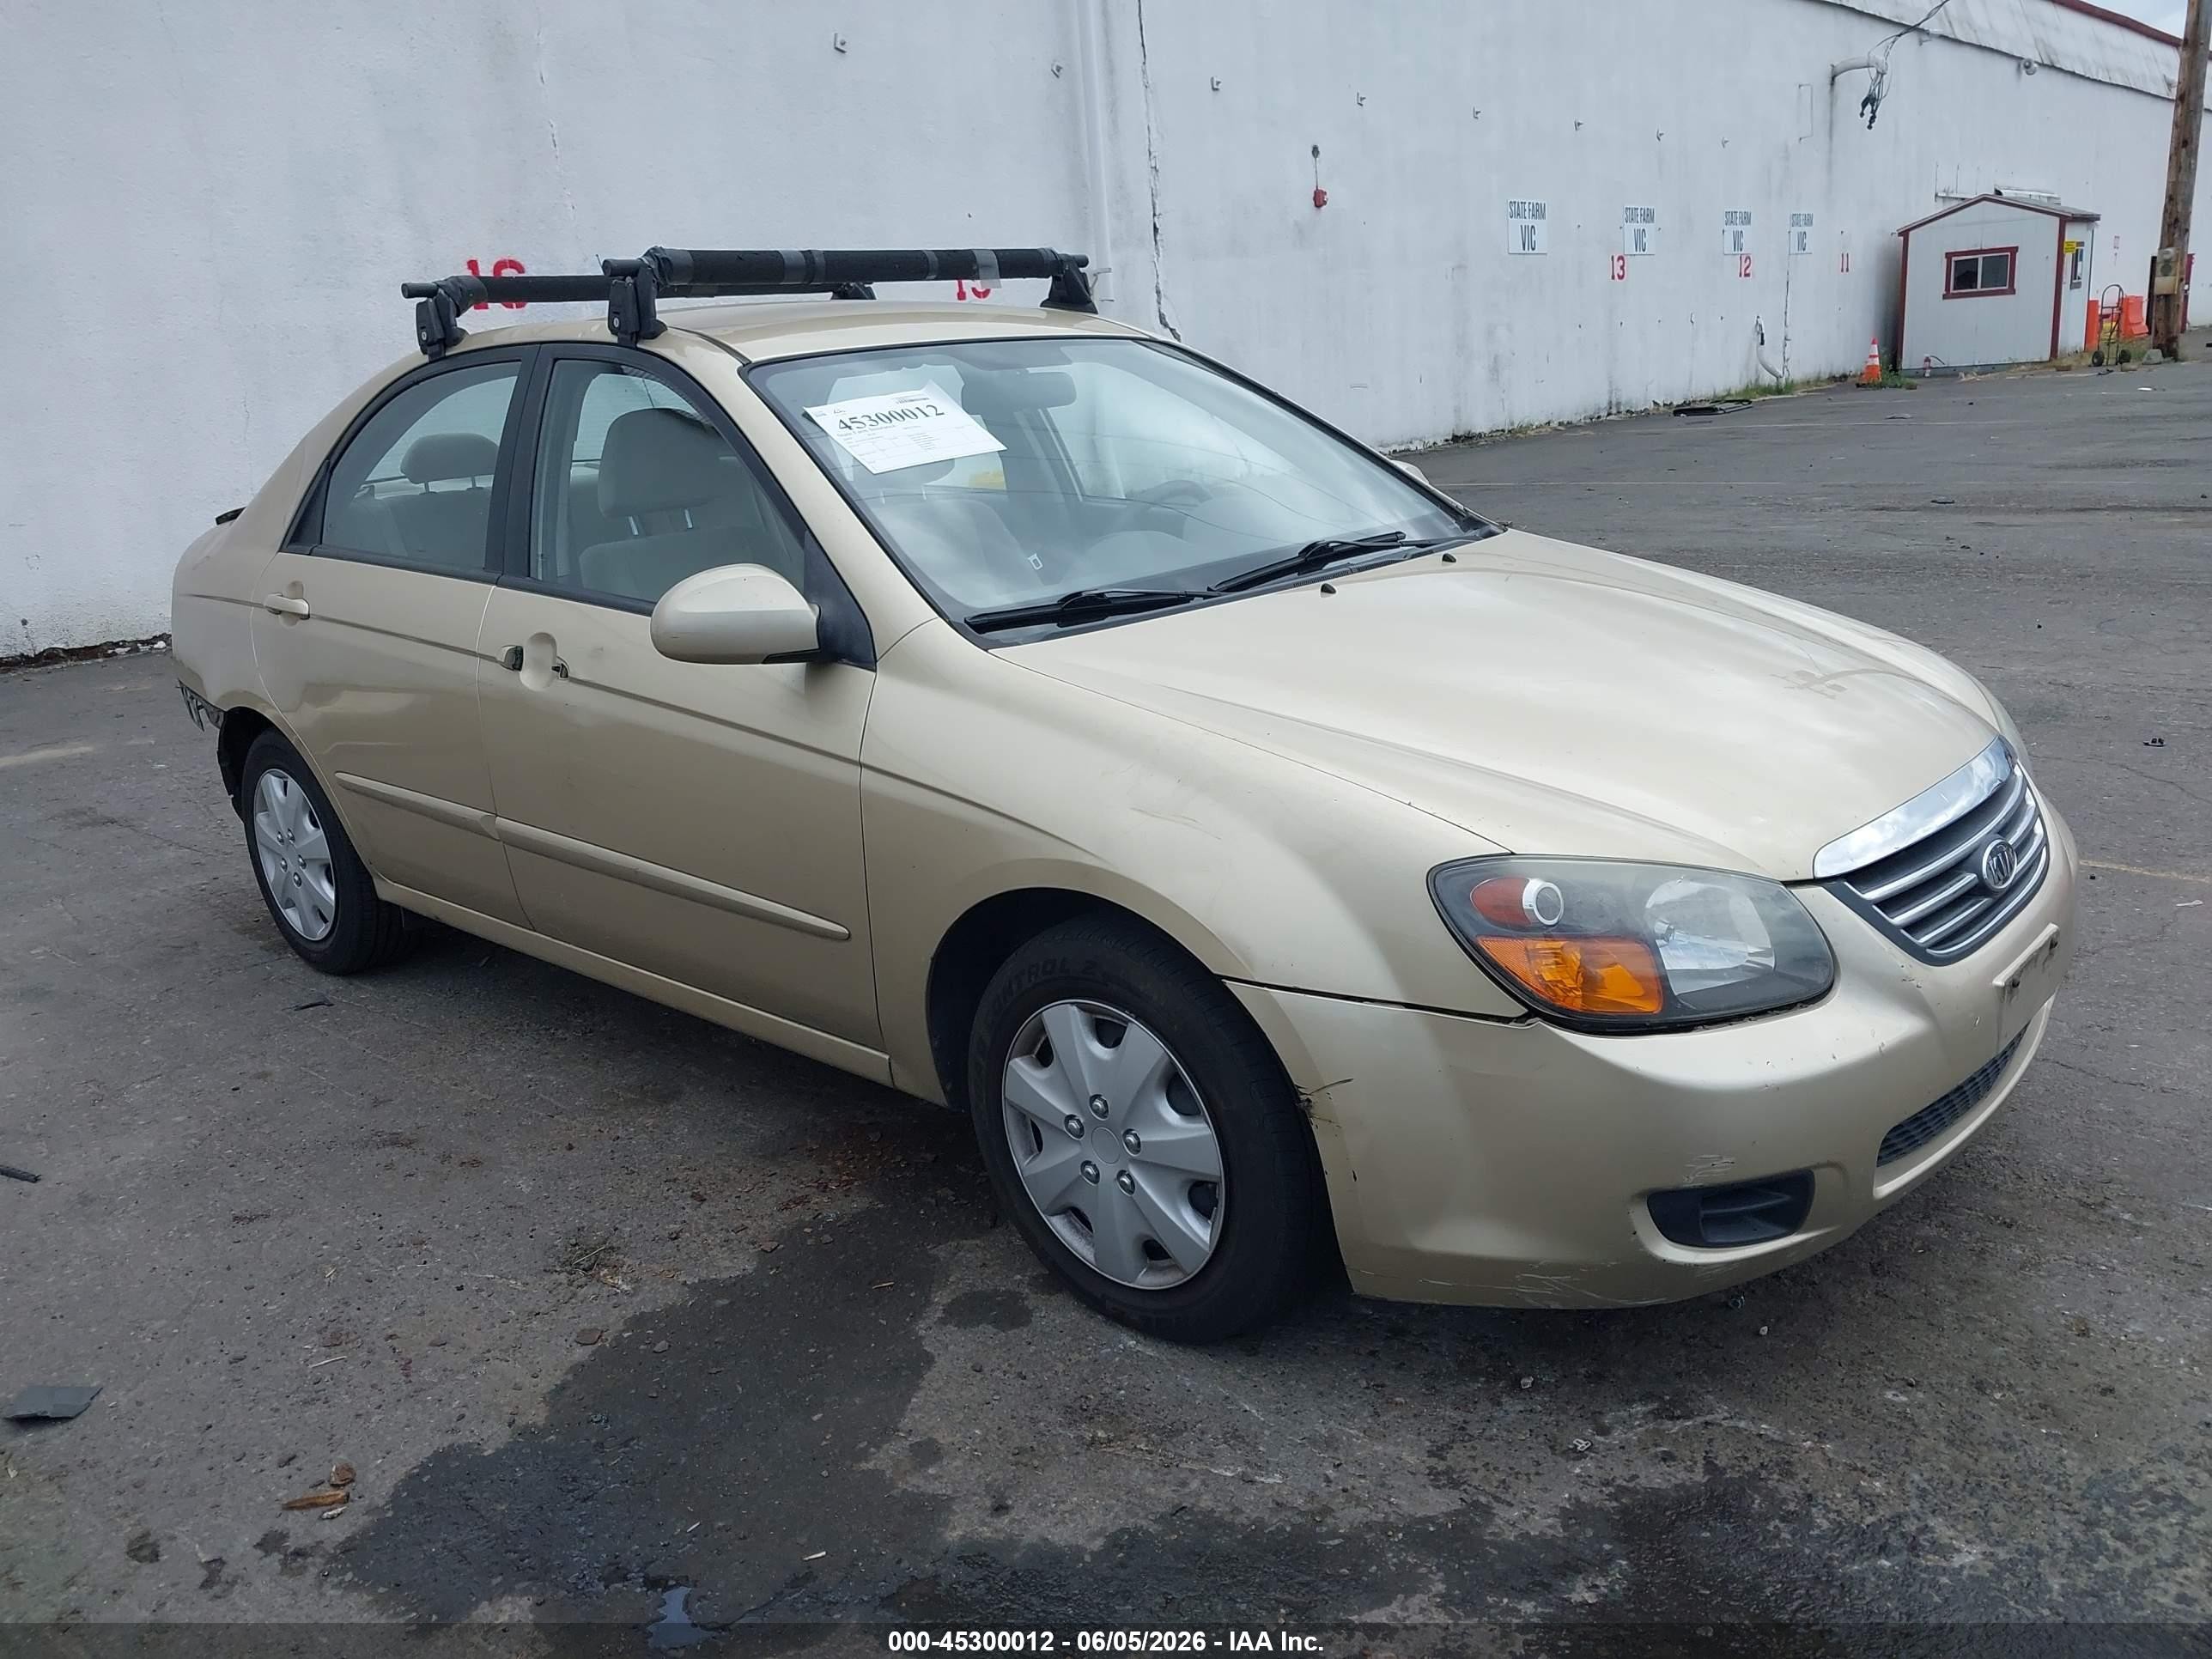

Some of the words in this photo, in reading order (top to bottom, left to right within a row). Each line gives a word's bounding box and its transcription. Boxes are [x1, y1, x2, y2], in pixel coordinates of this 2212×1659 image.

[1509, 200, 1527, 219] STATE
[1528, 201, 1547, 220] FARM
[1625, 207, 1639, 223] STATE
[1639, 207, 1655, 224] FARM
[1724, 211, 1738, 226] STATE
[1738, 211, 1752, 226] FARM
[1791, 213, 1802, 227] STATE
[1802, 213, 1814, 227] FARM
[1520, 224, 1536, 252] VIC
[1633, 228, 1647, 252] VIC
[1732, 229, 1744, 252] VIC
[1797, 231, 1807, 252] VIC
[1611, 254, 1626, 281] 13
[1738, 253, 1752, 277] 12
[1840, 252, 1850, 273] 11
[838, 404, 945, 431] 45300012
